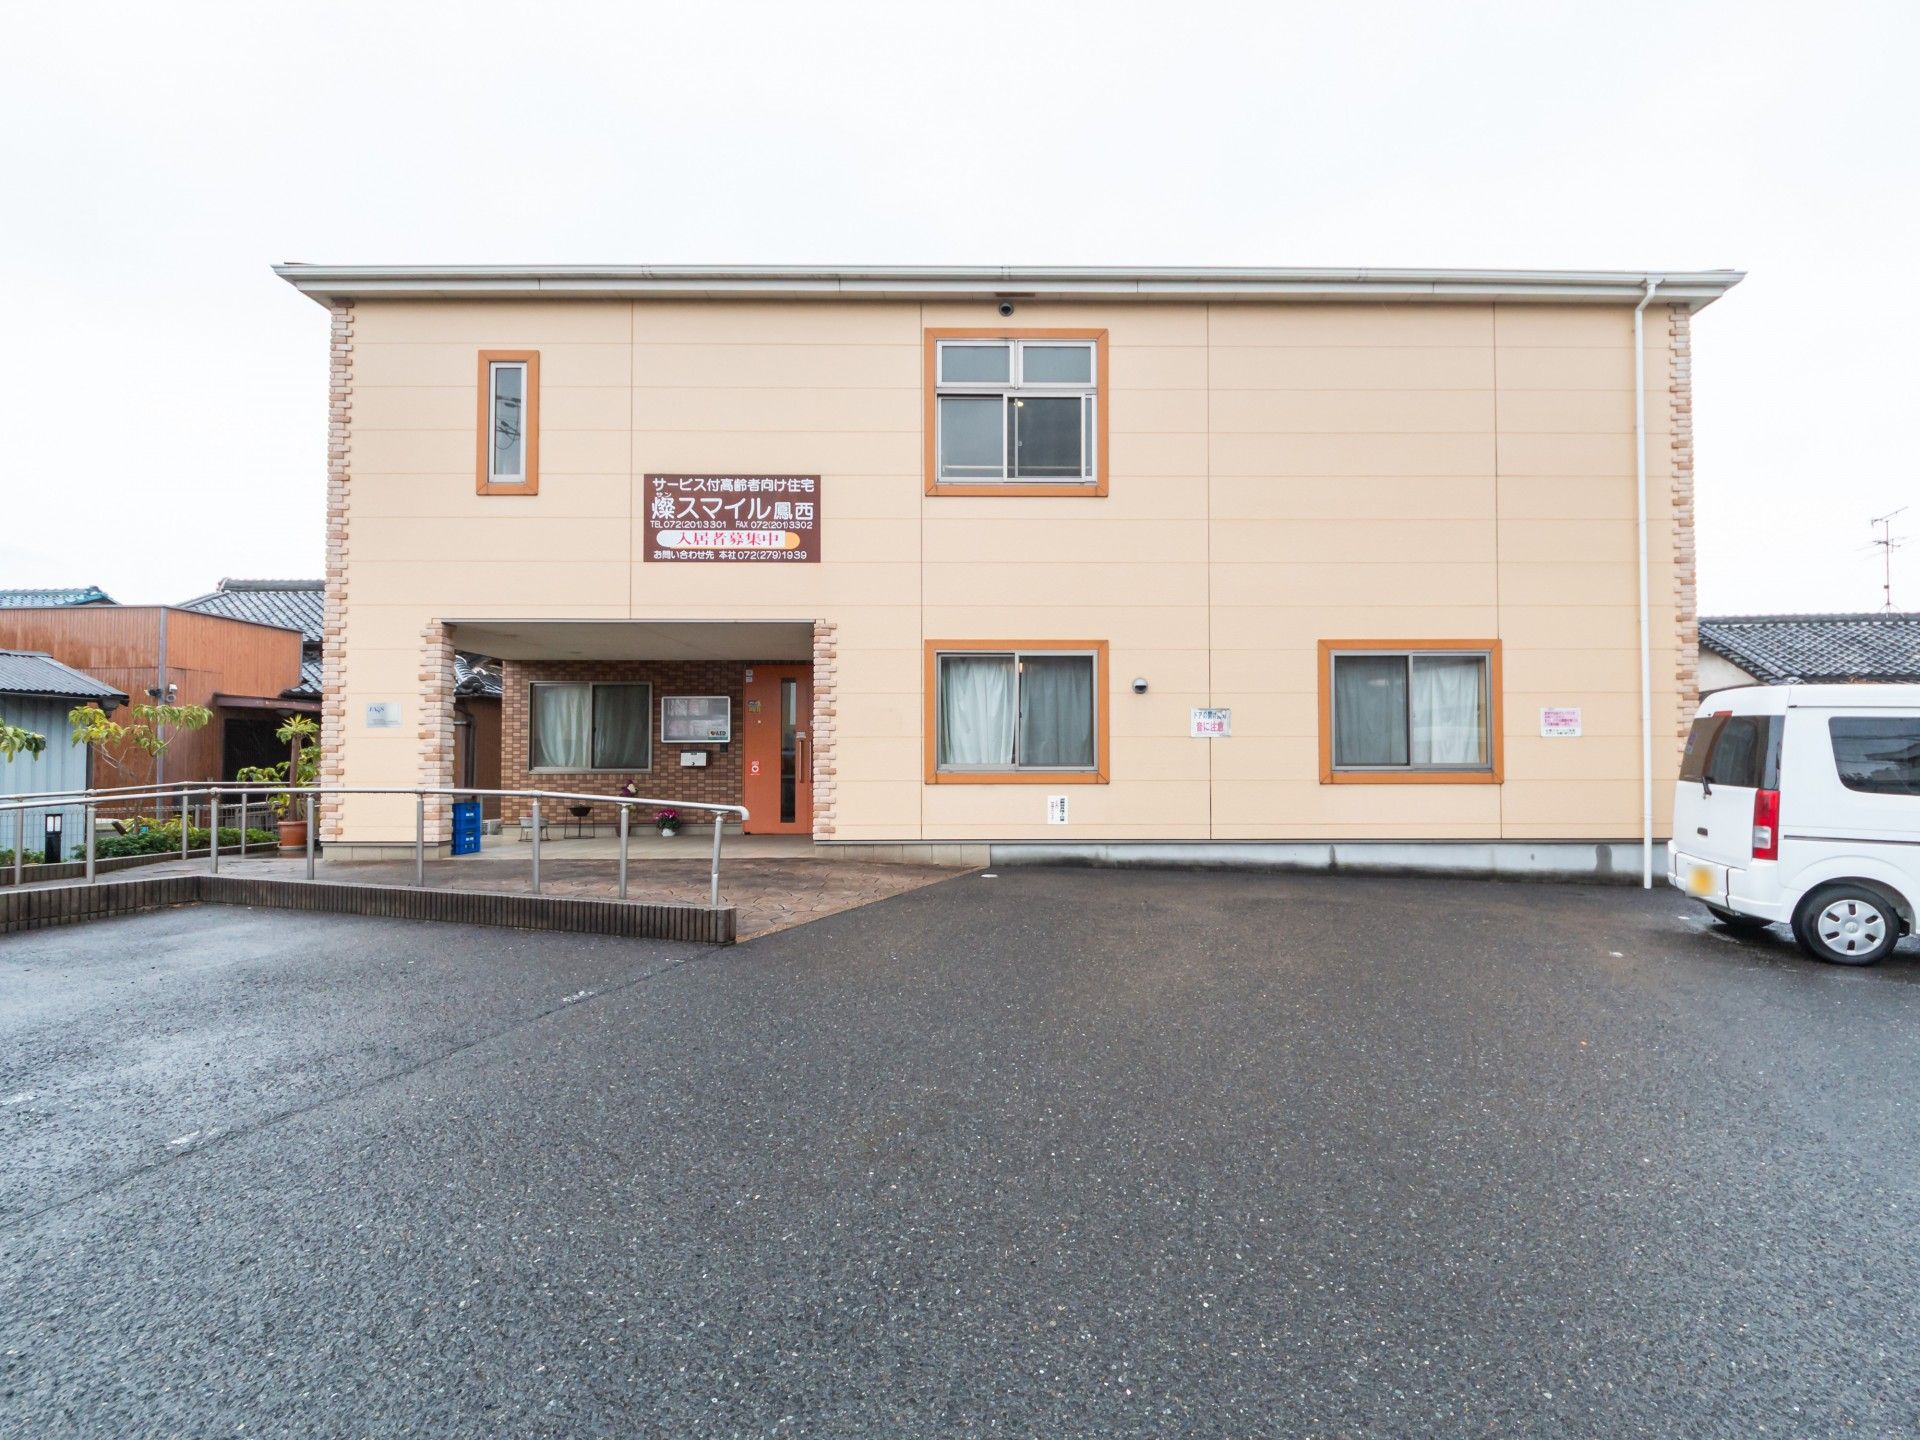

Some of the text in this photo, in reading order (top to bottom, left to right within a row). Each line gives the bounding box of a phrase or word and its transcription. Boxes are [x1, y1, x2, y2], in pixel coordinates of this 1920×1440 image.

[652, 477, 814, 492] サービス付高齢者向け住宅
[750, 521, 813, 529] 072(201)3302
[677, 531, 779, 546] 入居者募集中
[653, 550, 715, 559] お問い合わせ先
[1196, 721, 1224, 732] 音に注意
